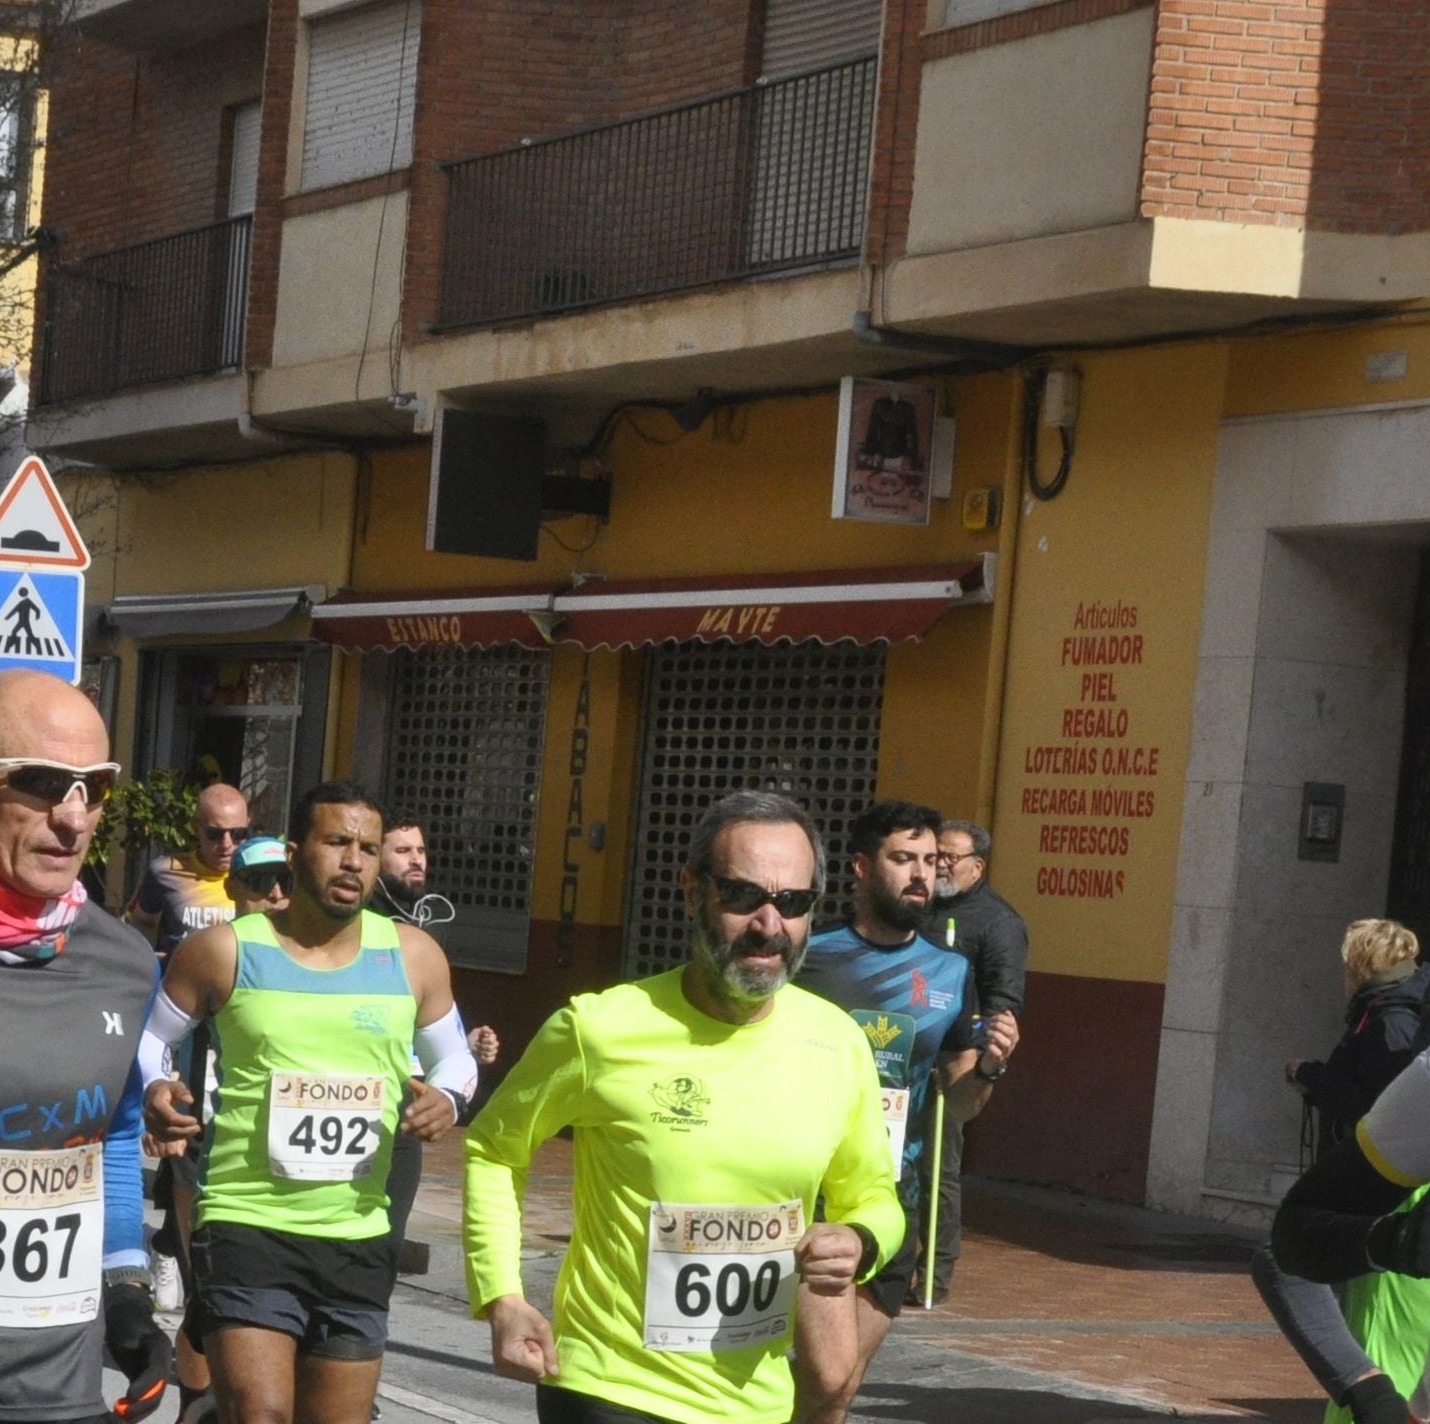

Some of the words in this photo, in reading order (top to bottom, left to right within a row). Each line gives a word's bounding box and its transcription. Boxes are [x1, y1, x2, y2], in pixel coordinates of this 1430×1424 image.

[696, 607, 781, 634] MAYTE
[1074, 599, 1138, 630] Artículos
[386, 616, 462, 643] ESTANCO
[1062, 634, 1143, 666] FUMADOR
[1081, 672, 1117, 701] PIEL
[1062, 709, 1129, 738] REGALO
[1022, 788, 1086, 815] RECARGA
[1091, 785, 1155, 818] MÓVILES
[1039, 825, 1130, 855] REFRESCOS
[299, 1083, 368, 1101] FONDO
[288, 1115, 369, 1156] 492
[32, 1156, 69, 1169] PREMIO
[689, 1218, 782, 1242] FONDO
[692, 1210, 724, 1221] GRAN
[728, 1210, 769, 1222] PREMIO
[675, 1260, 781, 1318] 600
